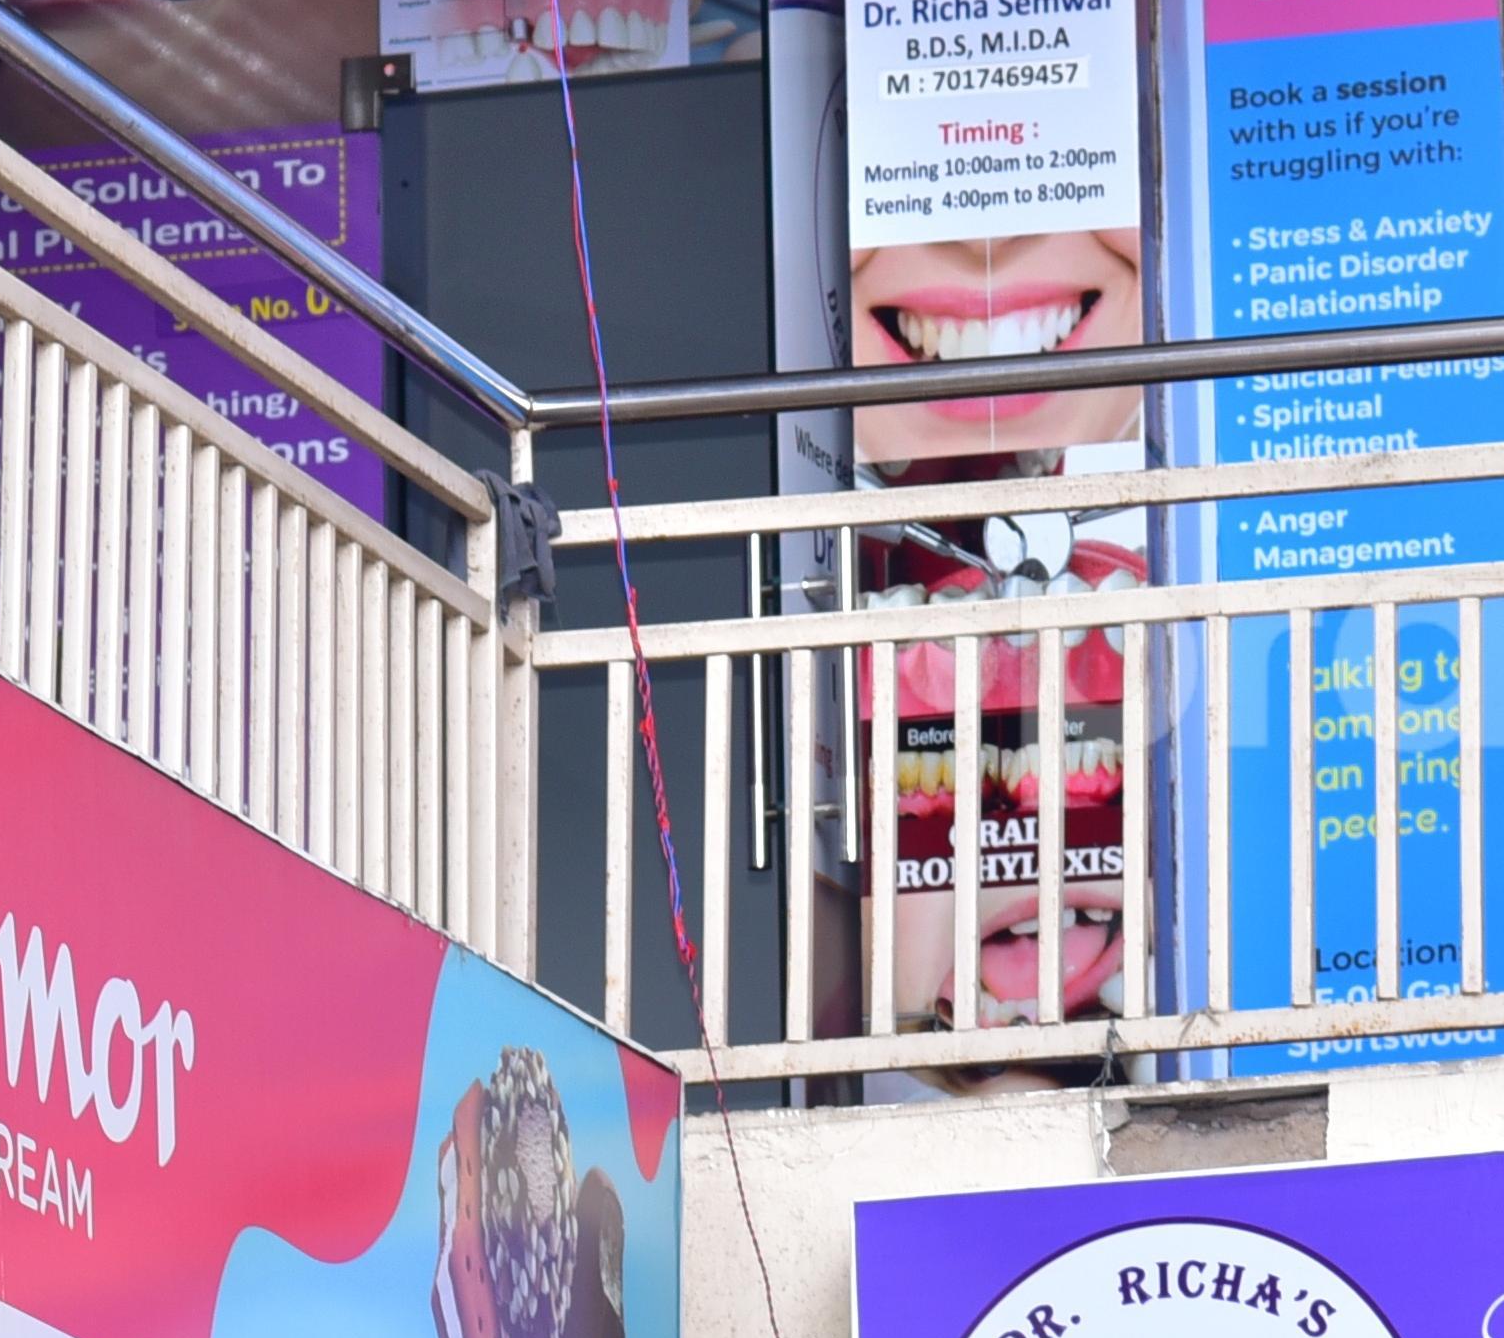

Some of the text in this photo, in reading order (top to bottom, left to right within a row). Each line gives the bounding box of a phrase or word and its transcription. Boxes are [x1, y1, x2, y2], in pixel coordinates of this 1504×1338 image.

[864, 2, 901, 28] Dr.
[907, 27, 1069, 60] B.D.S, M.I.D.A
[1230, 70, 1446, 110] Book a session
[1229, 106, 1459, 145] with us if you're
[865, 147, 1116, 183] Morning 10:00am to 2:00pm
[1232, 139, 1461, 181] struggling with:
[865, 181, 1104, 216] Evening 4:00pm to 8:00pm
[1249, 210, 1492, 251] Stress & Anxiety
[1250, 247, 1469, 287] Panic Disorder
[1251, 282, 1442, 321] Relationship
[1256, 509, 1348, 536] Anger
[1254, 532, 1454, 571] Management
